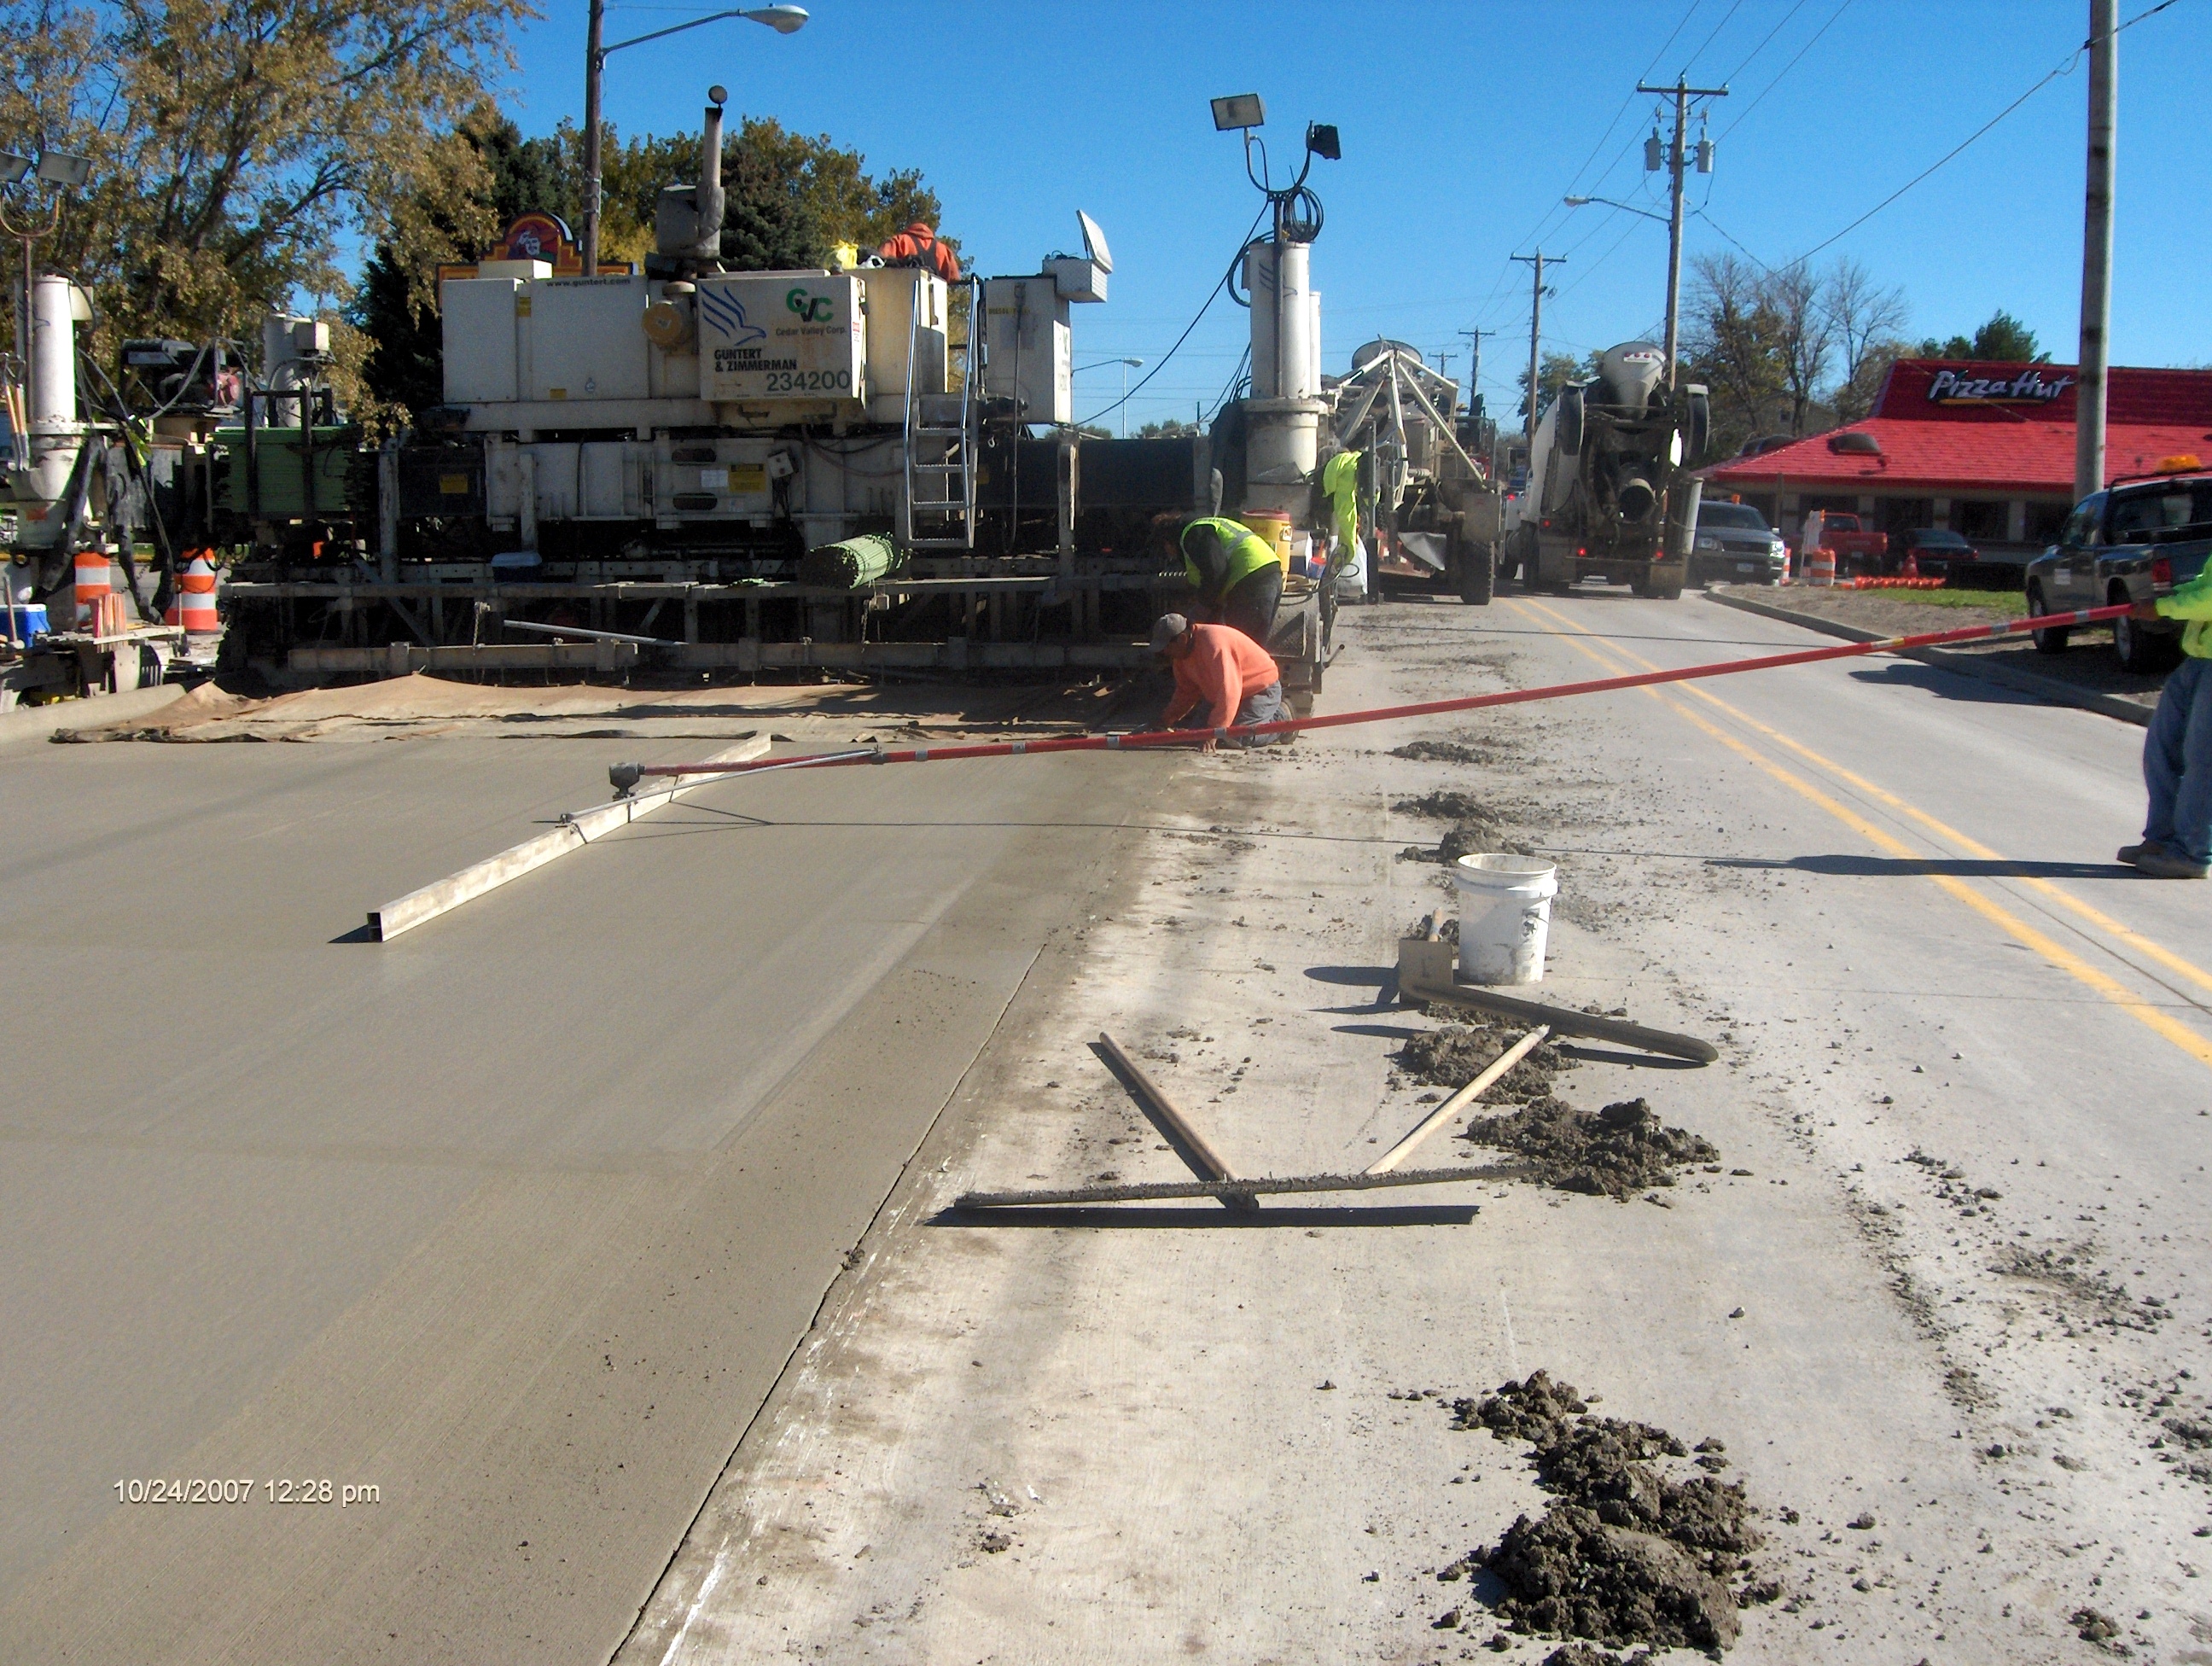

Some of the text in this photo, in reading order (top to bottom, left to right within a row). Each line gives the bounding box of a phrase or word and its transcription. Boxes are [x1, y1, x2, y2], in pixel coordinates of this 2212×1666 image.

[546, 278, 631, 288] www.guntert.com
[786, 288, 834, 322] CVC
[776, 327, 800, 336] Cedar
[800, 326, 825, 336] Valley
[826, 325, 847, 335] Corp.
[714, 348, 762, 360] GUNTERT
[715, 359, 797, 372] & ZIMMERMAN
[766, 368, 851, 392] 234200
[1928, 370, 2075, 399] Pizza Hut
